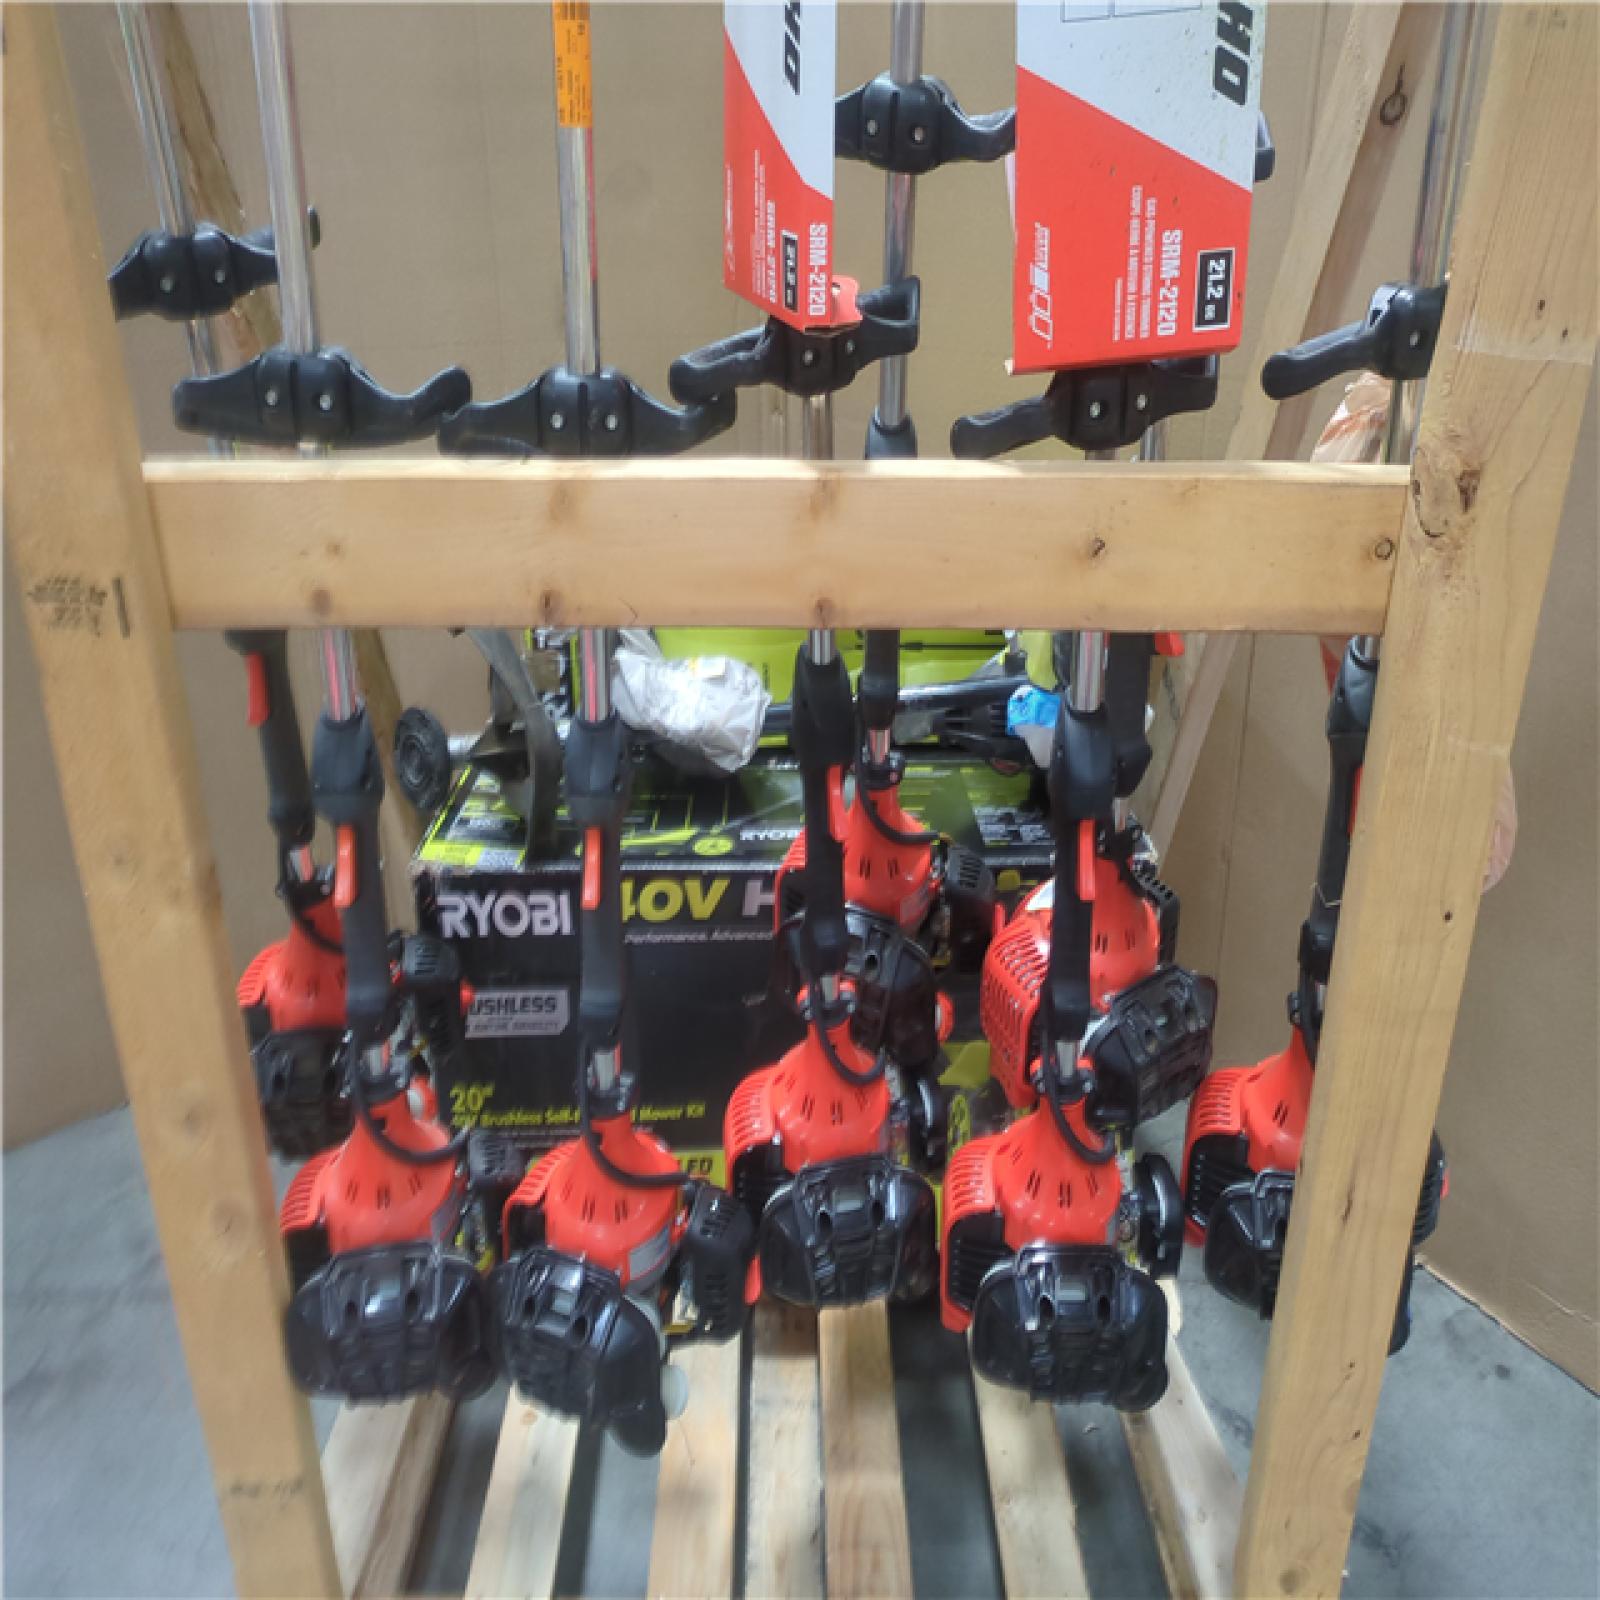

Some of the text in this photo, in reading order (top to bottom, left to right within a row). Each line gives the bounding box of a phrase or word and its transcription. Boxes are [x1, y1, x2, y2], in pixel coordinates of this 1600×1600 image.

[808, 222, 828, 316] SRM-2120
[1157, 228, 1182, 336] SRM-2120
[1207, 258, 1226, 300] 21.2
[435, 890, 574, 938] RYOBI
[480, 1110, 544, 1126] Brushless
[640, 1104, 683, 1121] Mower
